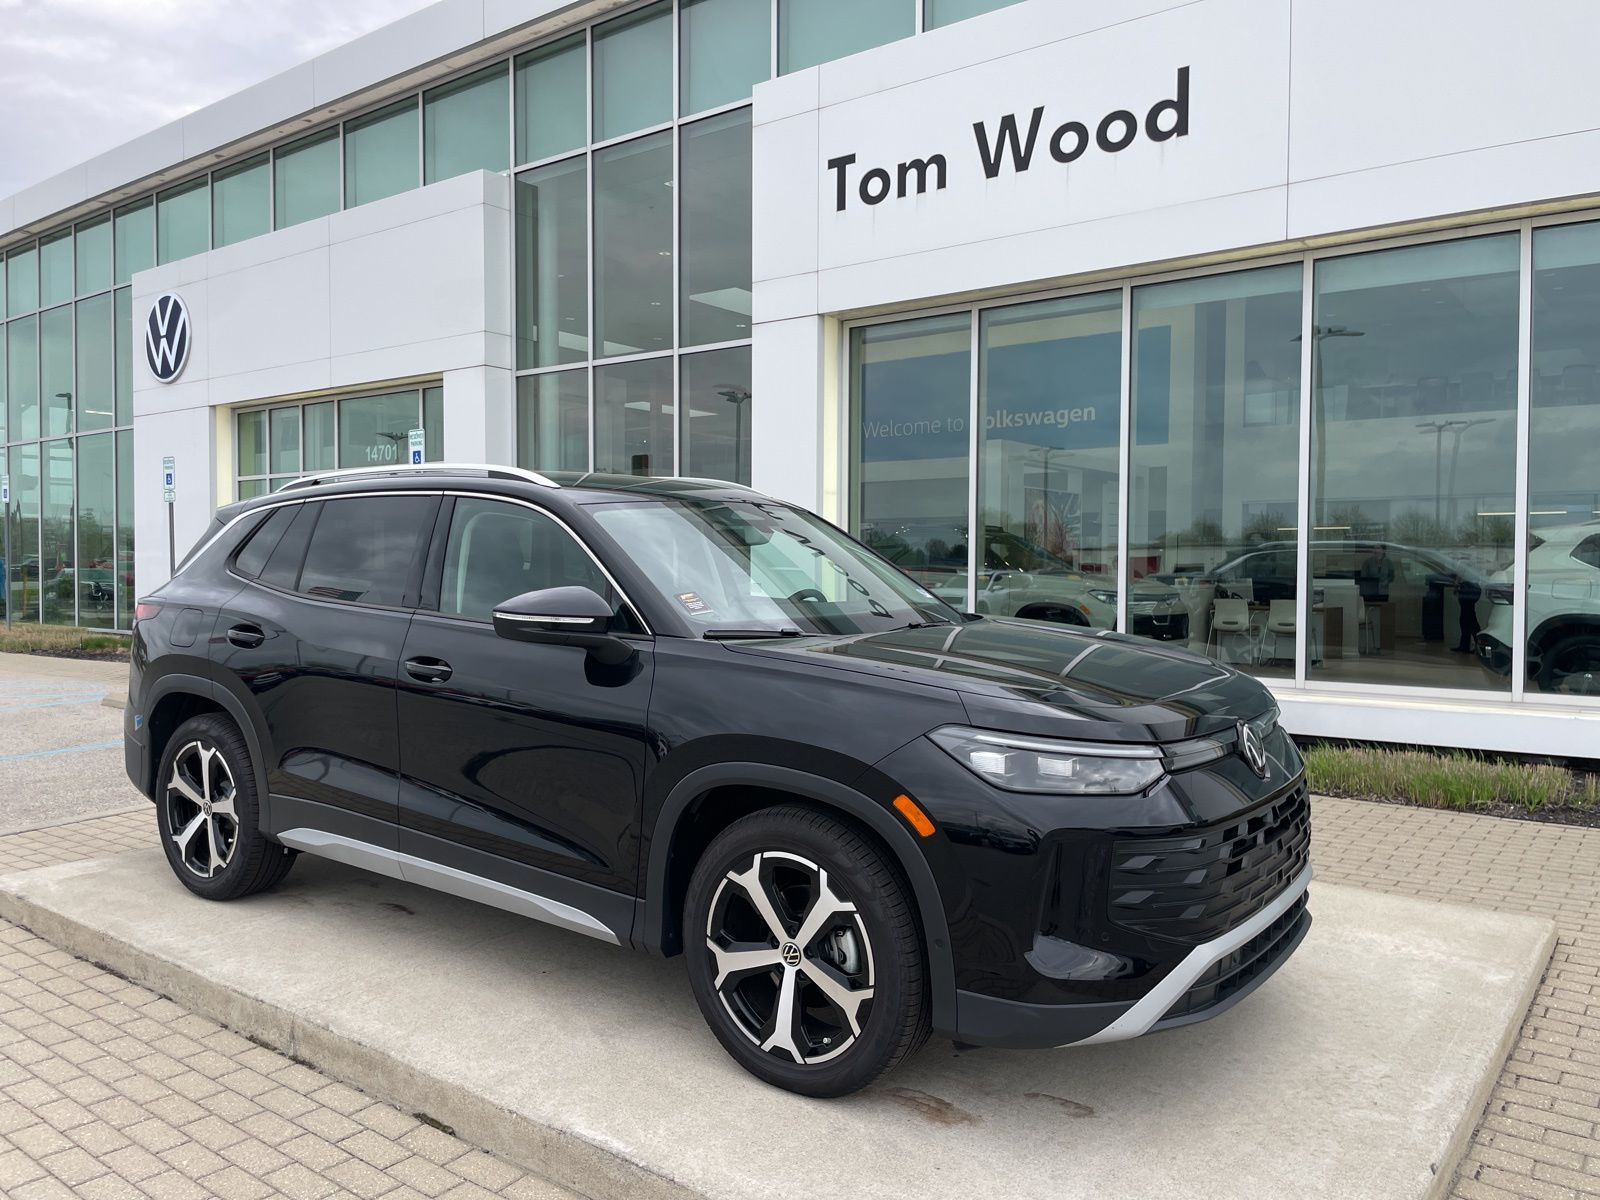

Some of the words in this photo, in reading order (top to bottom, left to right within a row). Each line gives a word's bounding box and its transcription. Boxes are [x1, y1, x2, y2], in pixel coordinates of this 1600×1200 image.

[828, 153, 947, 212] Tom
[973, 65, 1190, 179] Wood
[145, 293, 191, 383] VW
[365, 443, 398, 462] 14701
[863, 419, 942, 439] Welcome
[947, 417, 964, 432] to
[985, 405, 1096, 429] olkswagen
